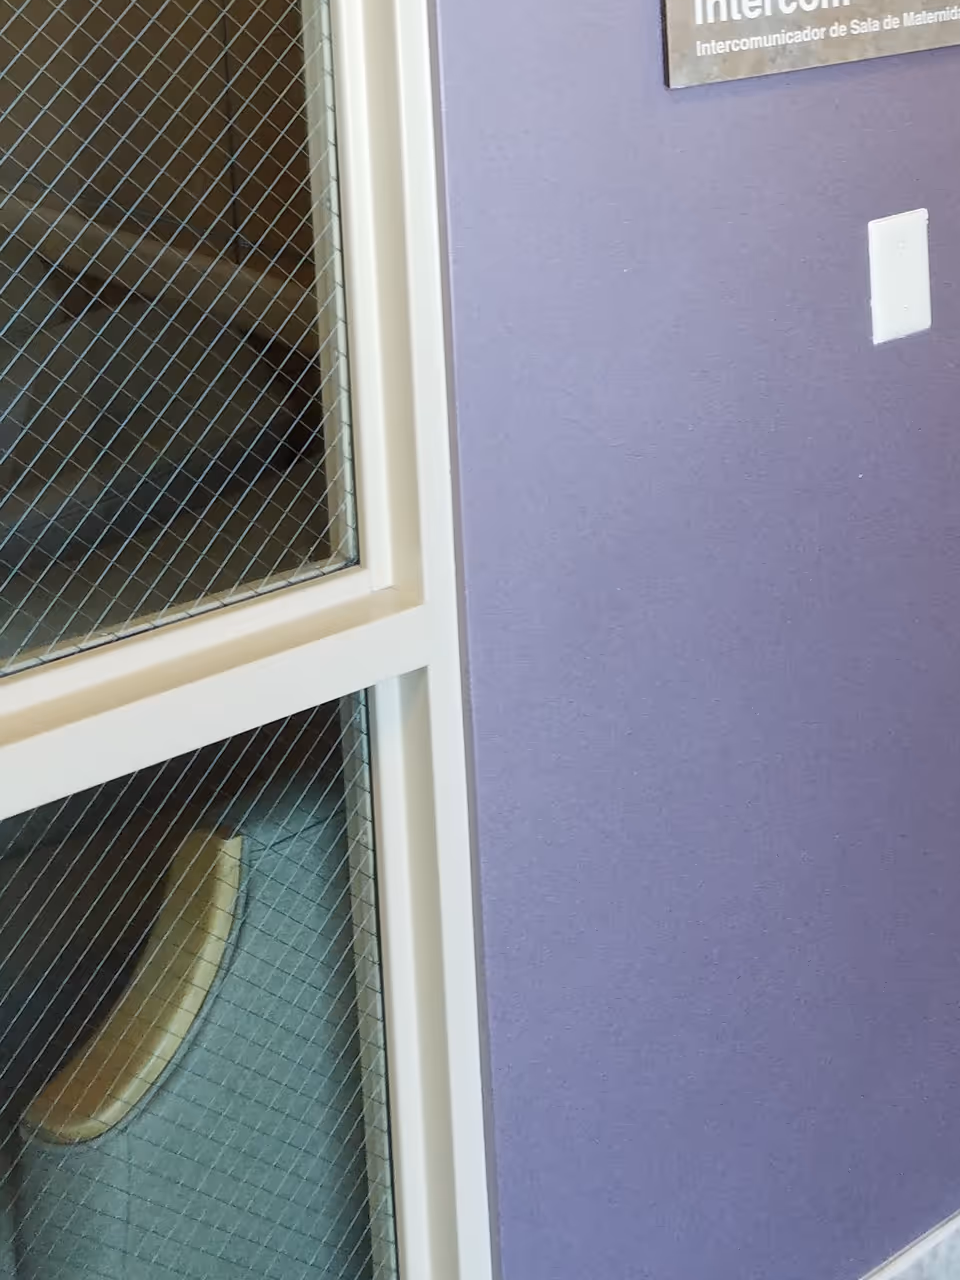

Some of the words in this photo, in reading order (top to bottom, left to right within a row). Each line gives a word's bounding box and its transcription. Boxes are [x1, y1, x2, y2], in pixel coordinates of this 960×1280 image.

[696, 25, 826, 56] Intercomunicador
[829, 21, 847, 37] de
[850, 17, 880, 35] Sala
[883, 14, 900, 30] de
